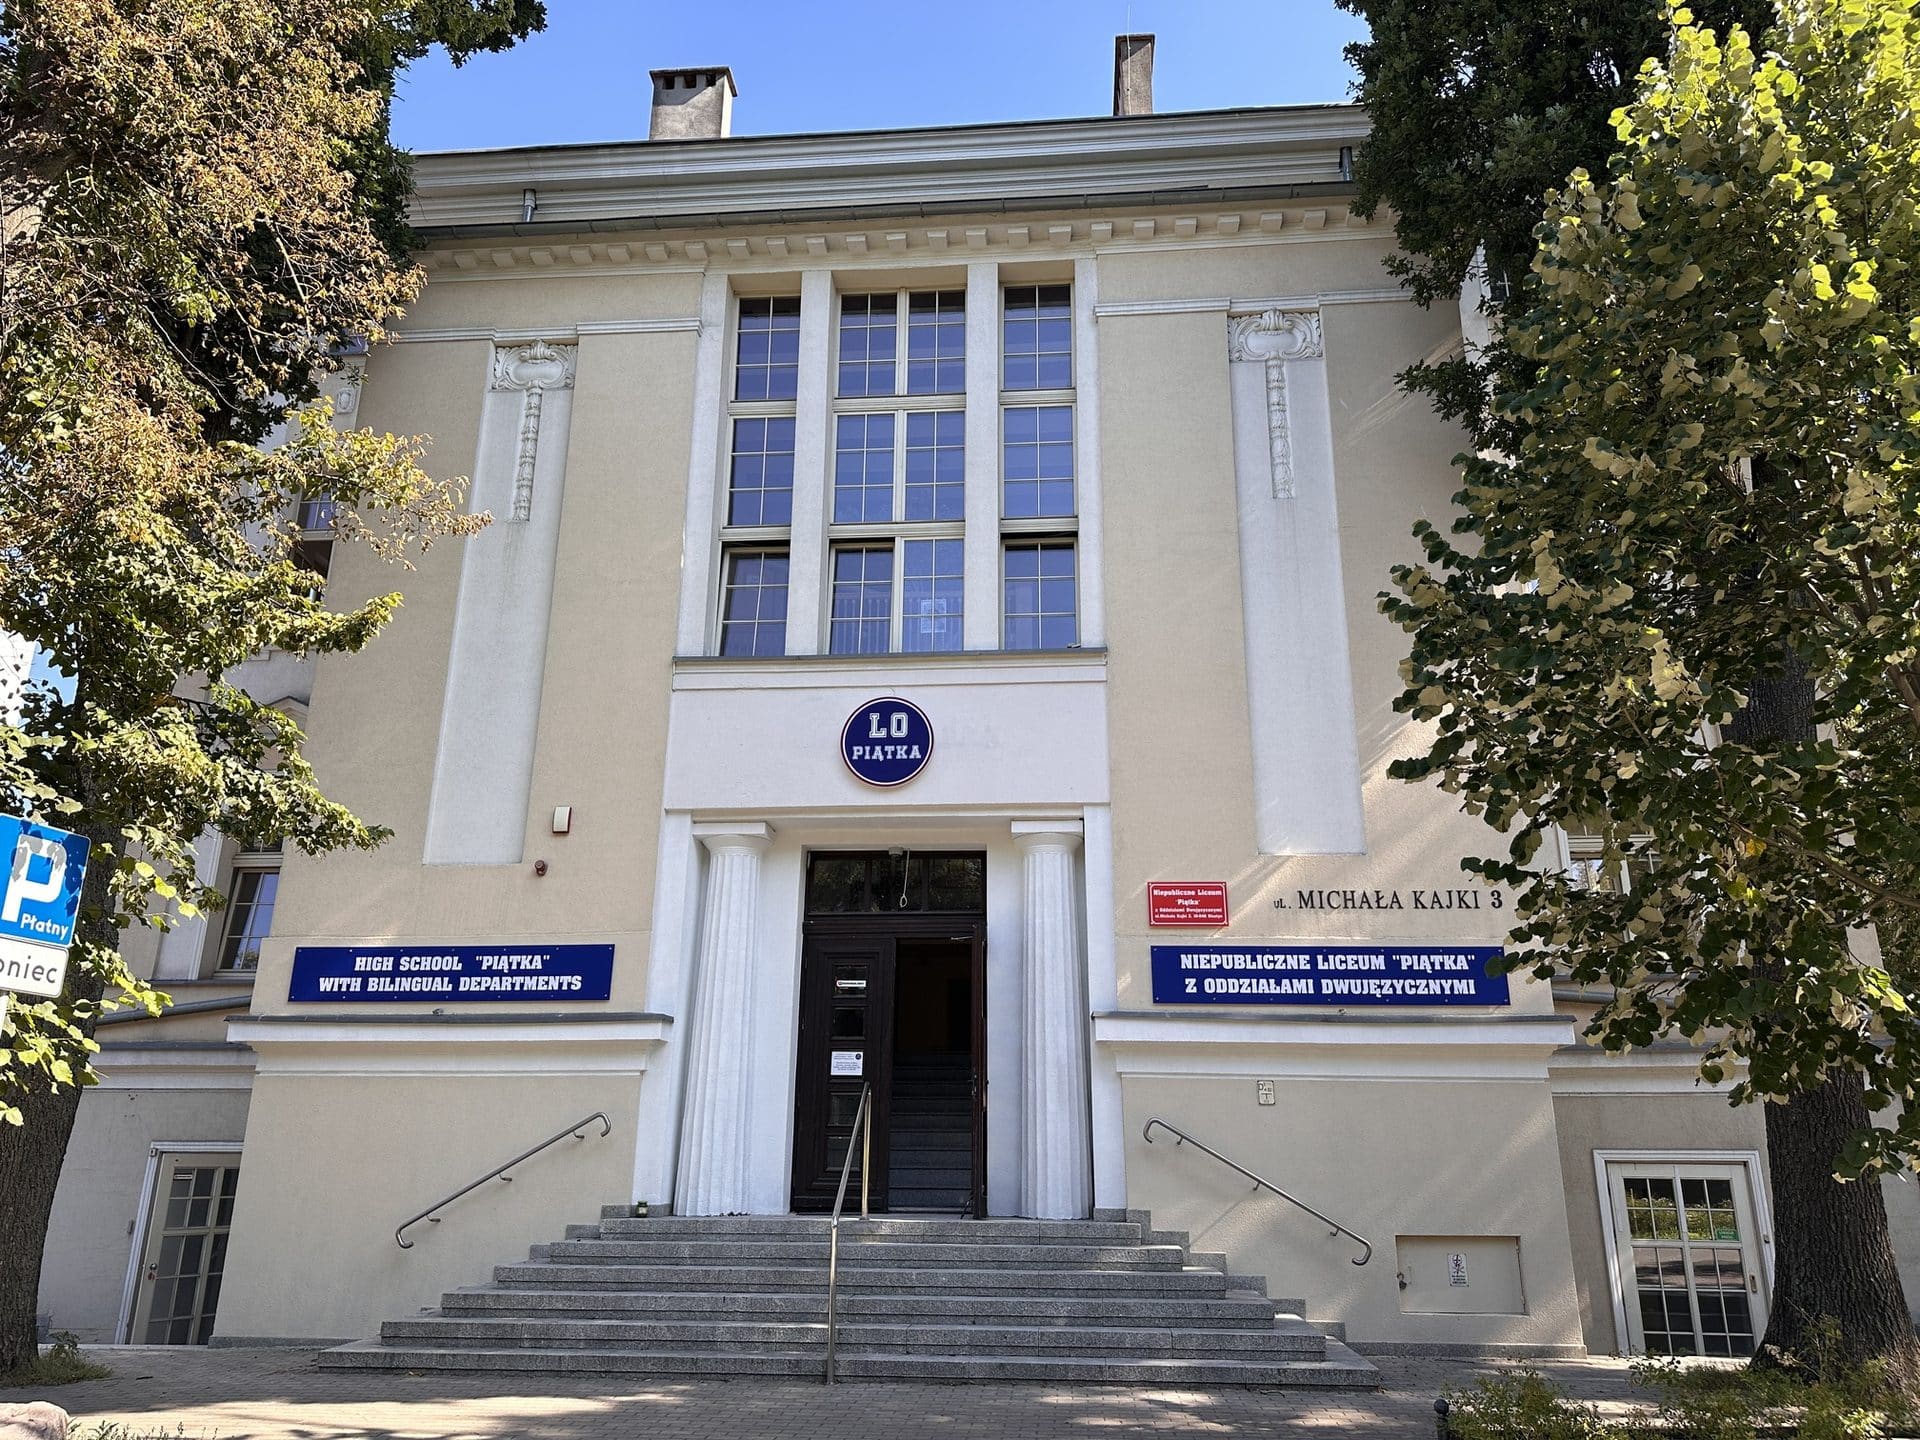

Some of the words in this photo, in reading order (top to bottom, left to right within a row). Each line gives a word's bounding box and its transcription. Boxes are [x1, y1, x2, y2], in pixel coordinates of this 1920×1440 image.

[869, 712, 908, 738] LO
[852, 745, 922, 761] PIĄTKA
[1, 834, 67, 922] P
[1297, 889, 1404, 909] MICHAŁA
[1412, 889, 1481, 909] KAJKI
[1490, 889, 1503, 909] 3
[20, 913, 69, 941] Płatny
[354, 956, 394, 971] HIGH
[399, 956, 463, 971] SCHOOL
[475, 954, 550, 973] "PIĄTKA"
[1180, 954, 1311, 970] NIEPUBLICZNE
[1317, 955, 1386, 970] LICEUM
[1392, 954, 1475, 973] "PIĄTKA"
[319, 977, 362, 992] WITH
[367, 976, 453, 992] BILINGUAL
[458, 975, 582, 992] DEPARTMENTS
[1185, 978, 1197, 993] Z
[1204, 978, 1314, 994] ODDZIAŁAMI
[1321, 979, 1476, 998] DWUJĘZYCZNYMI
